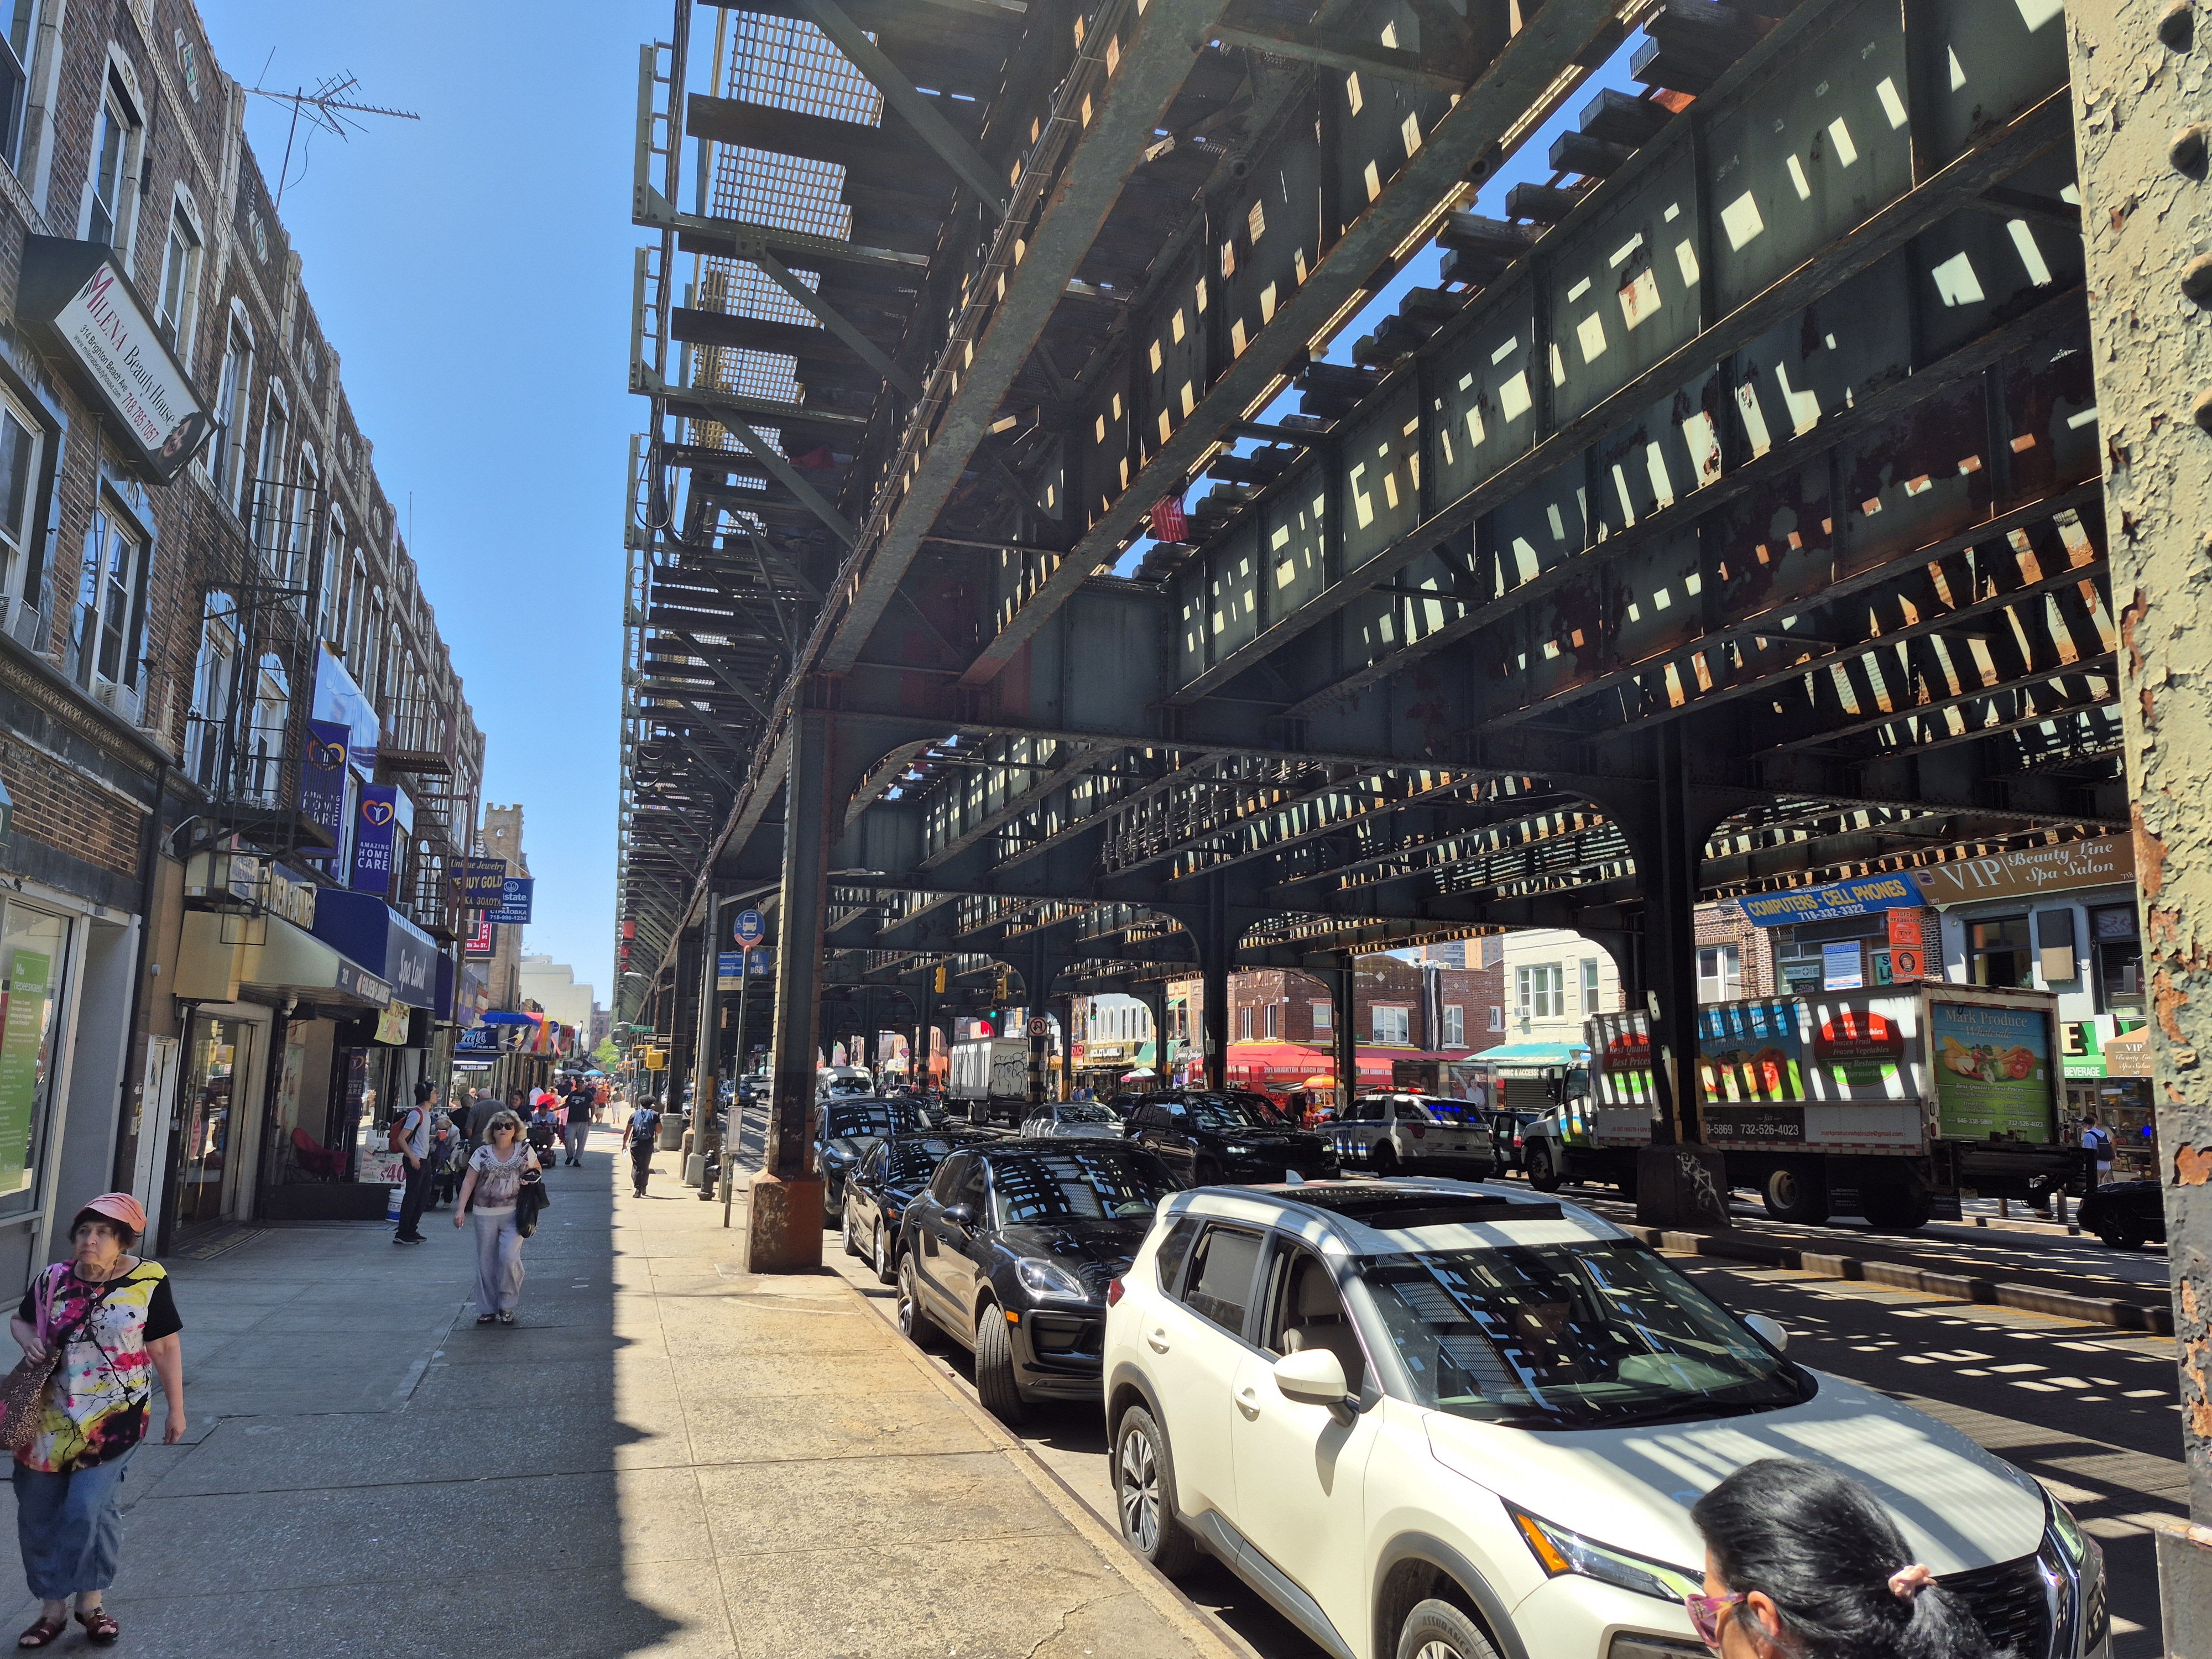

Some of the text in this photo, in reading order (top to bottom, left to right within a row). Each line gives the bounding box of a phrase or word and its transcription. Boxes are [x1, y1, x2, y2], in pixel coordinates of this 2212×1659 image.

[87, 267, 175, 426] MILENA Beauty House
[80, 325, 128, 392] 314 Brighton Beach Ave
[74, 334, 122, 399] www.milenabeautyhouse.com
[122, 392, 159, 442] 718.785.7057
[360, 842, 389, 850] AMAZING
[359, 848, 389, 859] HOME
[357, 858, 388, 870] CARE
[477, 860, 504, 872] Jewelry
[1938, 842, 2114, 890] VIP Beauty Line
[2026, 860, 2115, 886] Spa Salon
[481, 875, 503, 889] GOLD
[477, 897, 501, 906] ЗОЛОТА
[1747, 879, 1907, 917] COMPUTERS CELL PHONES
[1797, 904, 1867, 921] 718-332-3322
[1825, 943, 1858, 952] COMPUTERS
[15, 963, 25, 975] Мы
[398, 948, 427, 993] Spa Land
[750, 965, 763, 973] B68
[1726, 1009, 1781, 1031] Produce
[1945, 1009, 2028, 1027] Mark Produce
[1850, 1028, 1884, 1038] Vegetables
[1965, 1025, 2012, 1039] Wholesale
[2060, 1022, 2083, 1053] E
[1708, 1035, 1759, 1048] Wholesale
[1609, 1045, 1651, 1055] Best Qualit
[1855, 1046, 1890, 1056] Vegetables
[2125, 1044, 2143, 1052] VIP
[1612, 1057, 1651, 1067] Best Prices
[1827, 1058, 1896, 1068] Serving Restaurants
[2115, 1053, 2139, 1062] Beauty
[1839, 1068, 1887, 1078] Supermarkets
[2064, 1066, 2100, 1077] BEVERAGE
[1762, 1113, 1773, 1123] fax
[1957, 1117, 1993, 1125] 646-338-5869
[1740, 1124, 1799, 1136] 732-526-4023
